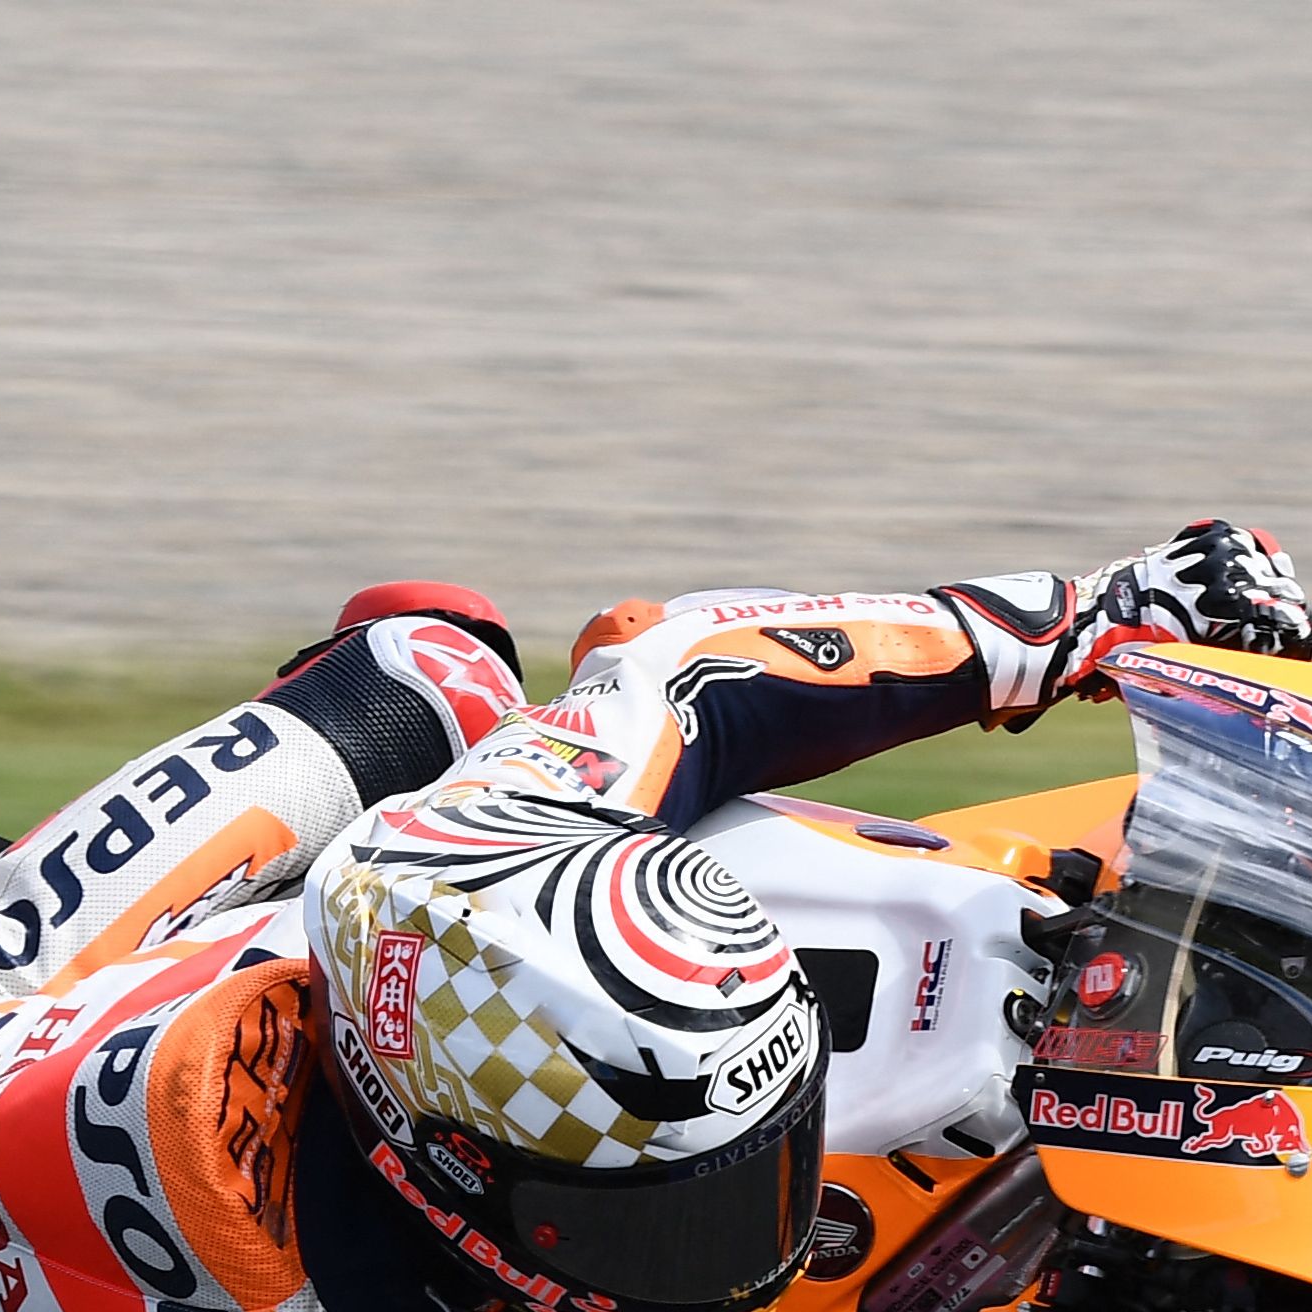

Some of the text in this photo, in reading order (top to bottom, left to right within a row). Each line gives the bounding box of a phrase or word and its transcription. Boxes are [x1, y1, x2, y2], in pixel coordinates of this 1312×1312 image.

[910, 940, 946, 1031] HRC
[337, 1027, 406, 1136] SHOEI
[725, 1013, 805, 1106] SHOEI
[1193, 1046, 1304, 1073] Puig
[1030, 1088, 1185, 1141] Red Bull
[435, 1147, 475, 1190] SHOEI
[693, 1134, 769, 1179] GIVES
[368, 1139, 567, 1308] Red Bull
